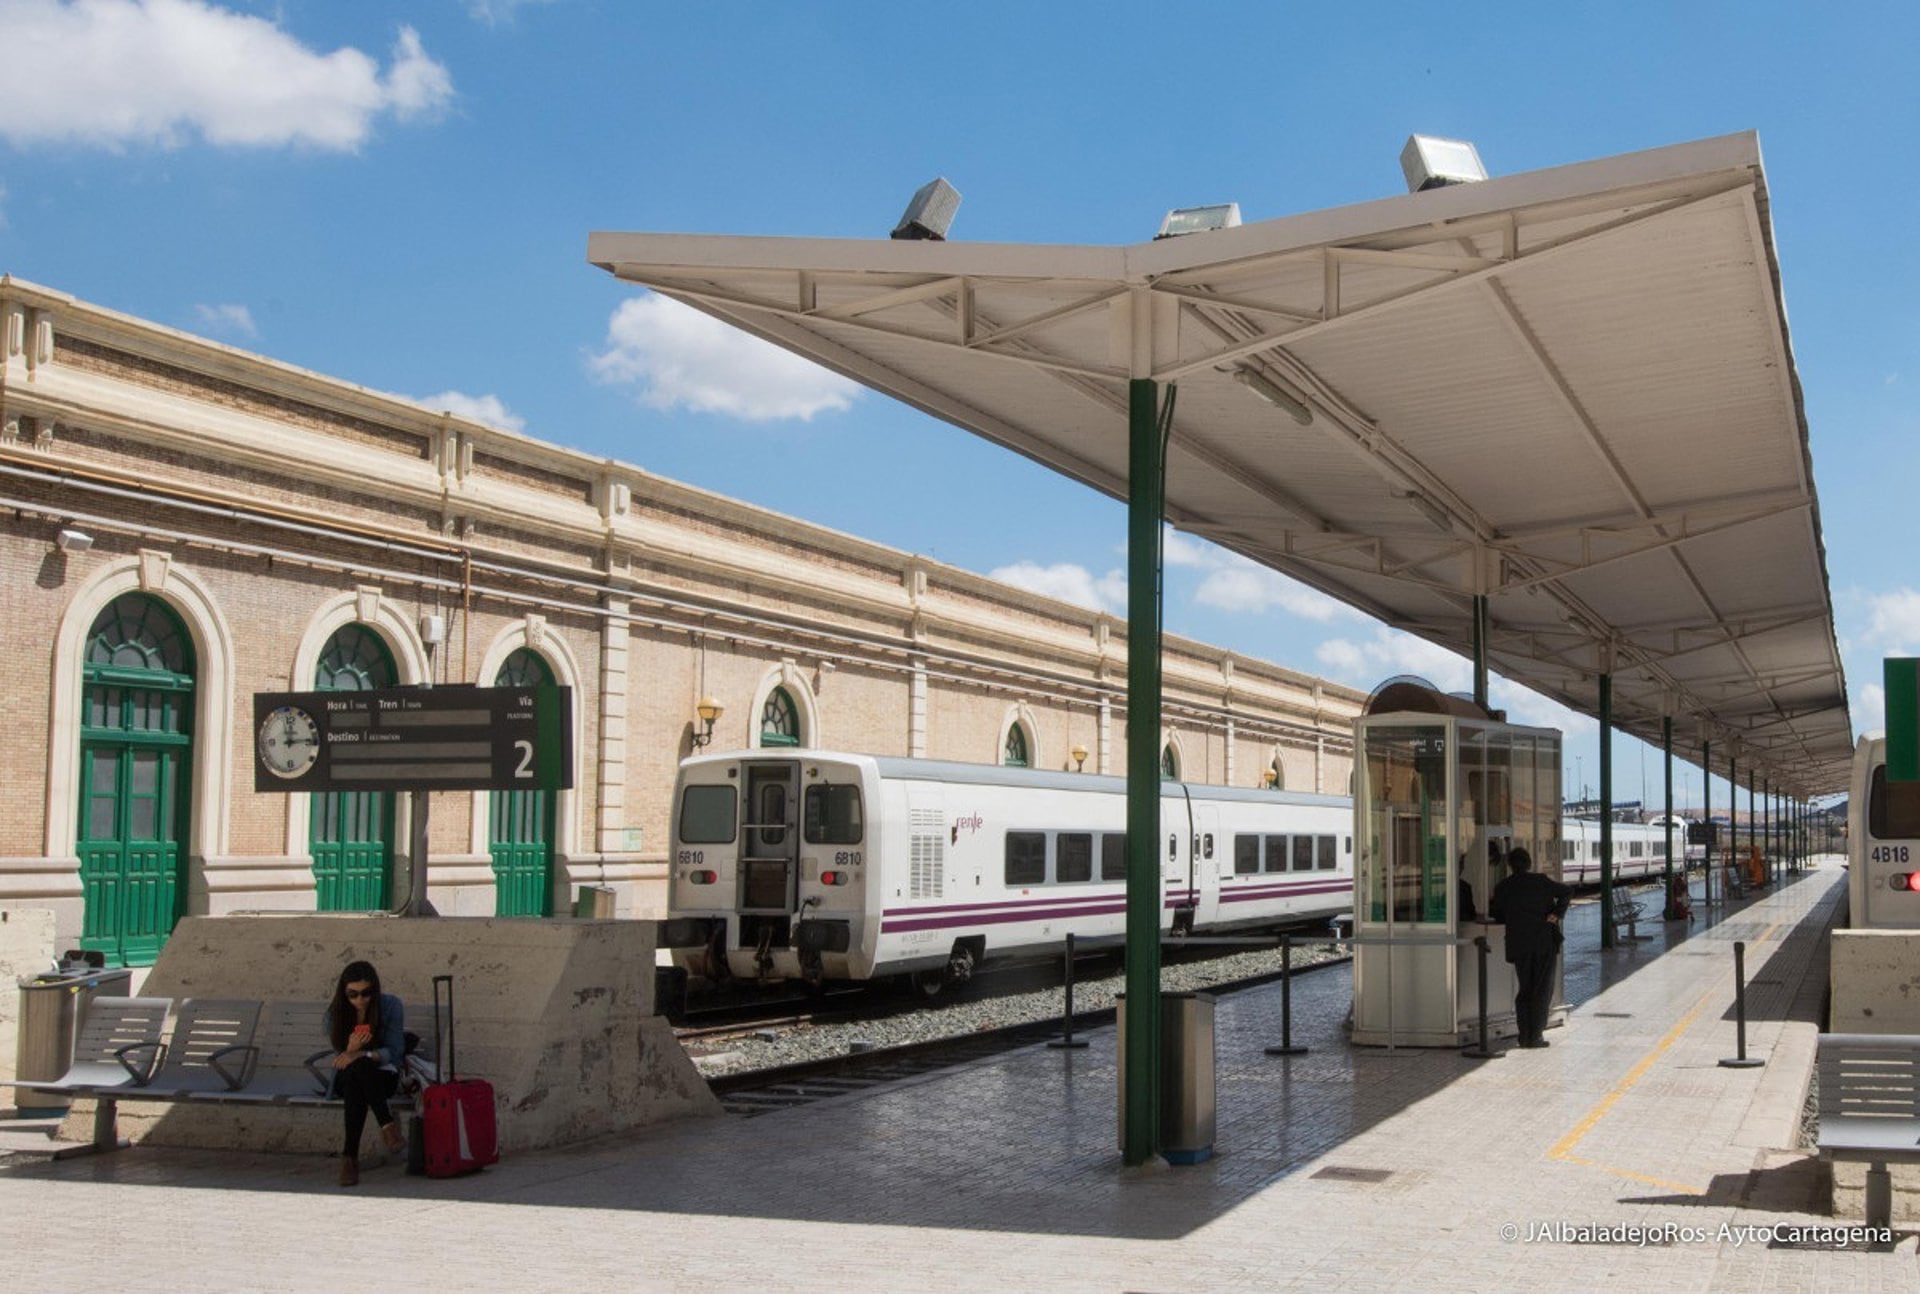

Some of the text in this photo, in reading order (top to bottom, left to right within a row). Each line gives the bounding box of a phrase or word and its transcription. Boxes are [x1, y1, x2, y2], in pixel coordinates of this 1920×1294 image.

[327, 701, 347, 711] Hora
[379, 699, 398, 709] Tren
[327, 732, 360, 742] Destino
[514, 740, 534, 778] 2
